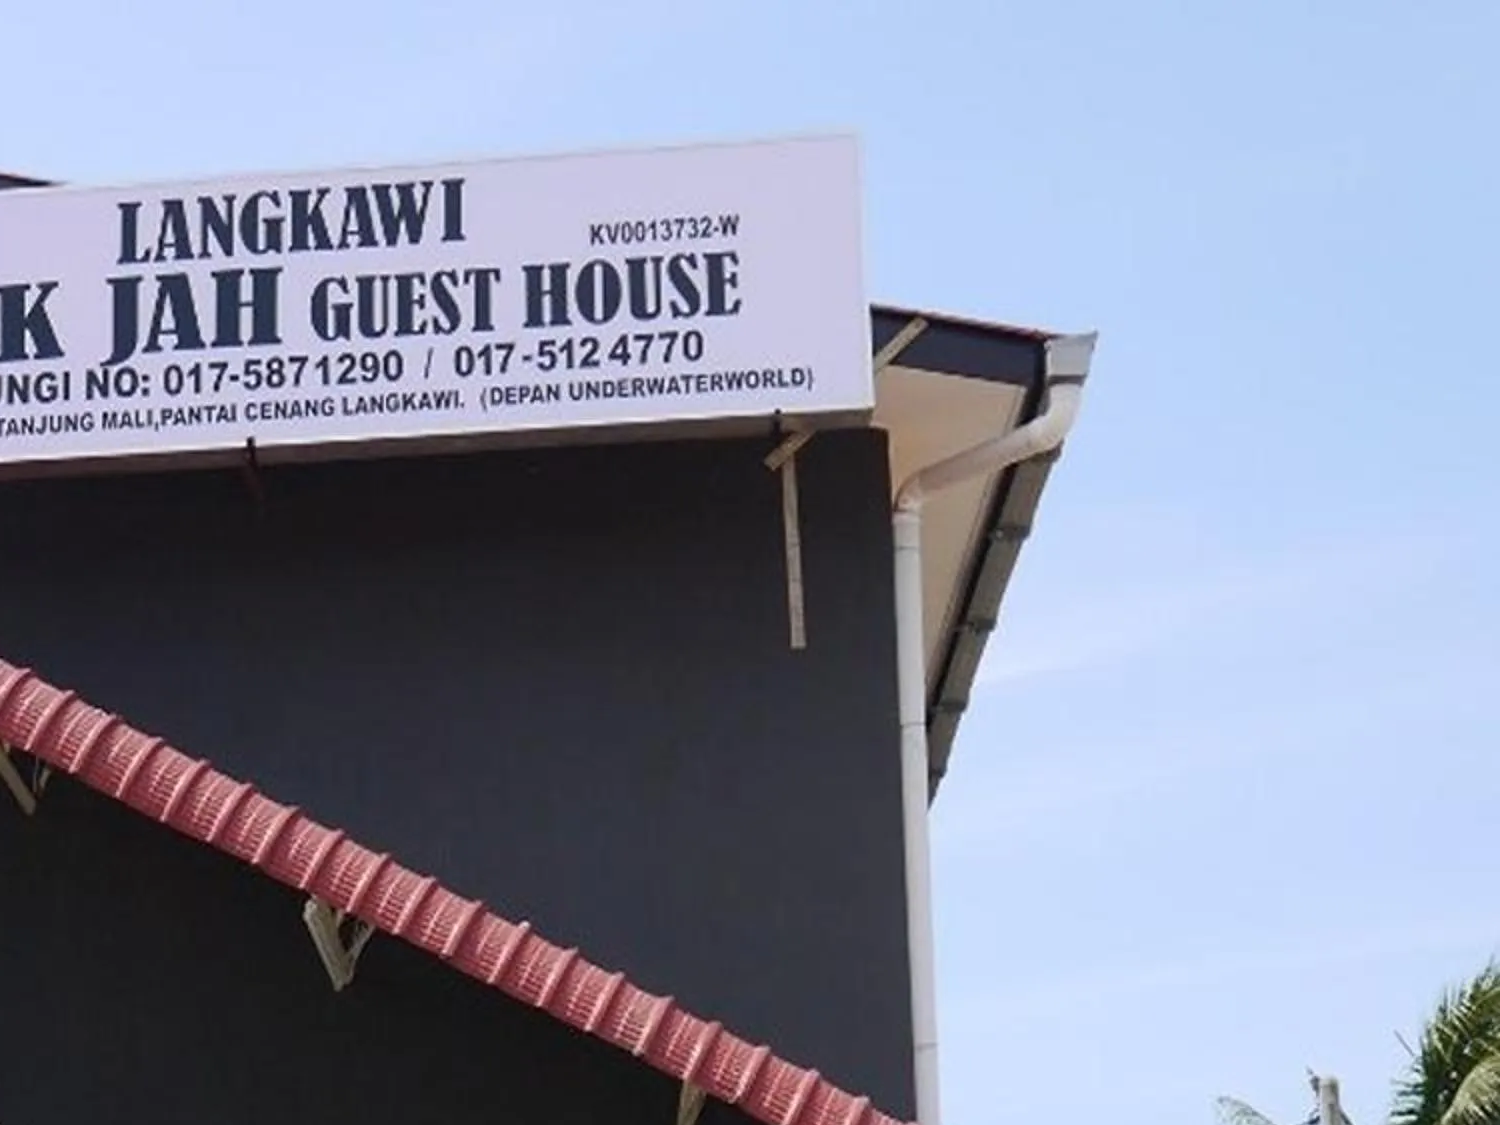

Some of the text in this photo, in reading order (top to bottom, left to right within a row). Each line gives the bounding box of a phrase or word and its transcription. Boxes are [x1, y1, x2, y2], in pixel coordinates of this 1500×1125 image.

[116, 177, 467, 266] LANGKAWI
[589, 214, 740, 247] KV0013732-W
[99, 265, 284, 367] JAH
[310, 267, 502, 342] GUEST
[521, 250, 743, 329] HOUSE
[84, 365, 151, 401] NO:
[163, 349, 404, 397] 017-5871290
[423, 347, 434, 380] /
[243, 397, 336, 422] CENANG
[341, 389, 465, 417] LANGKAWI.
[479, 383, 561, 411] (DEPAN
[568, 366, 814, 402] UNDERWATERWORLD)
